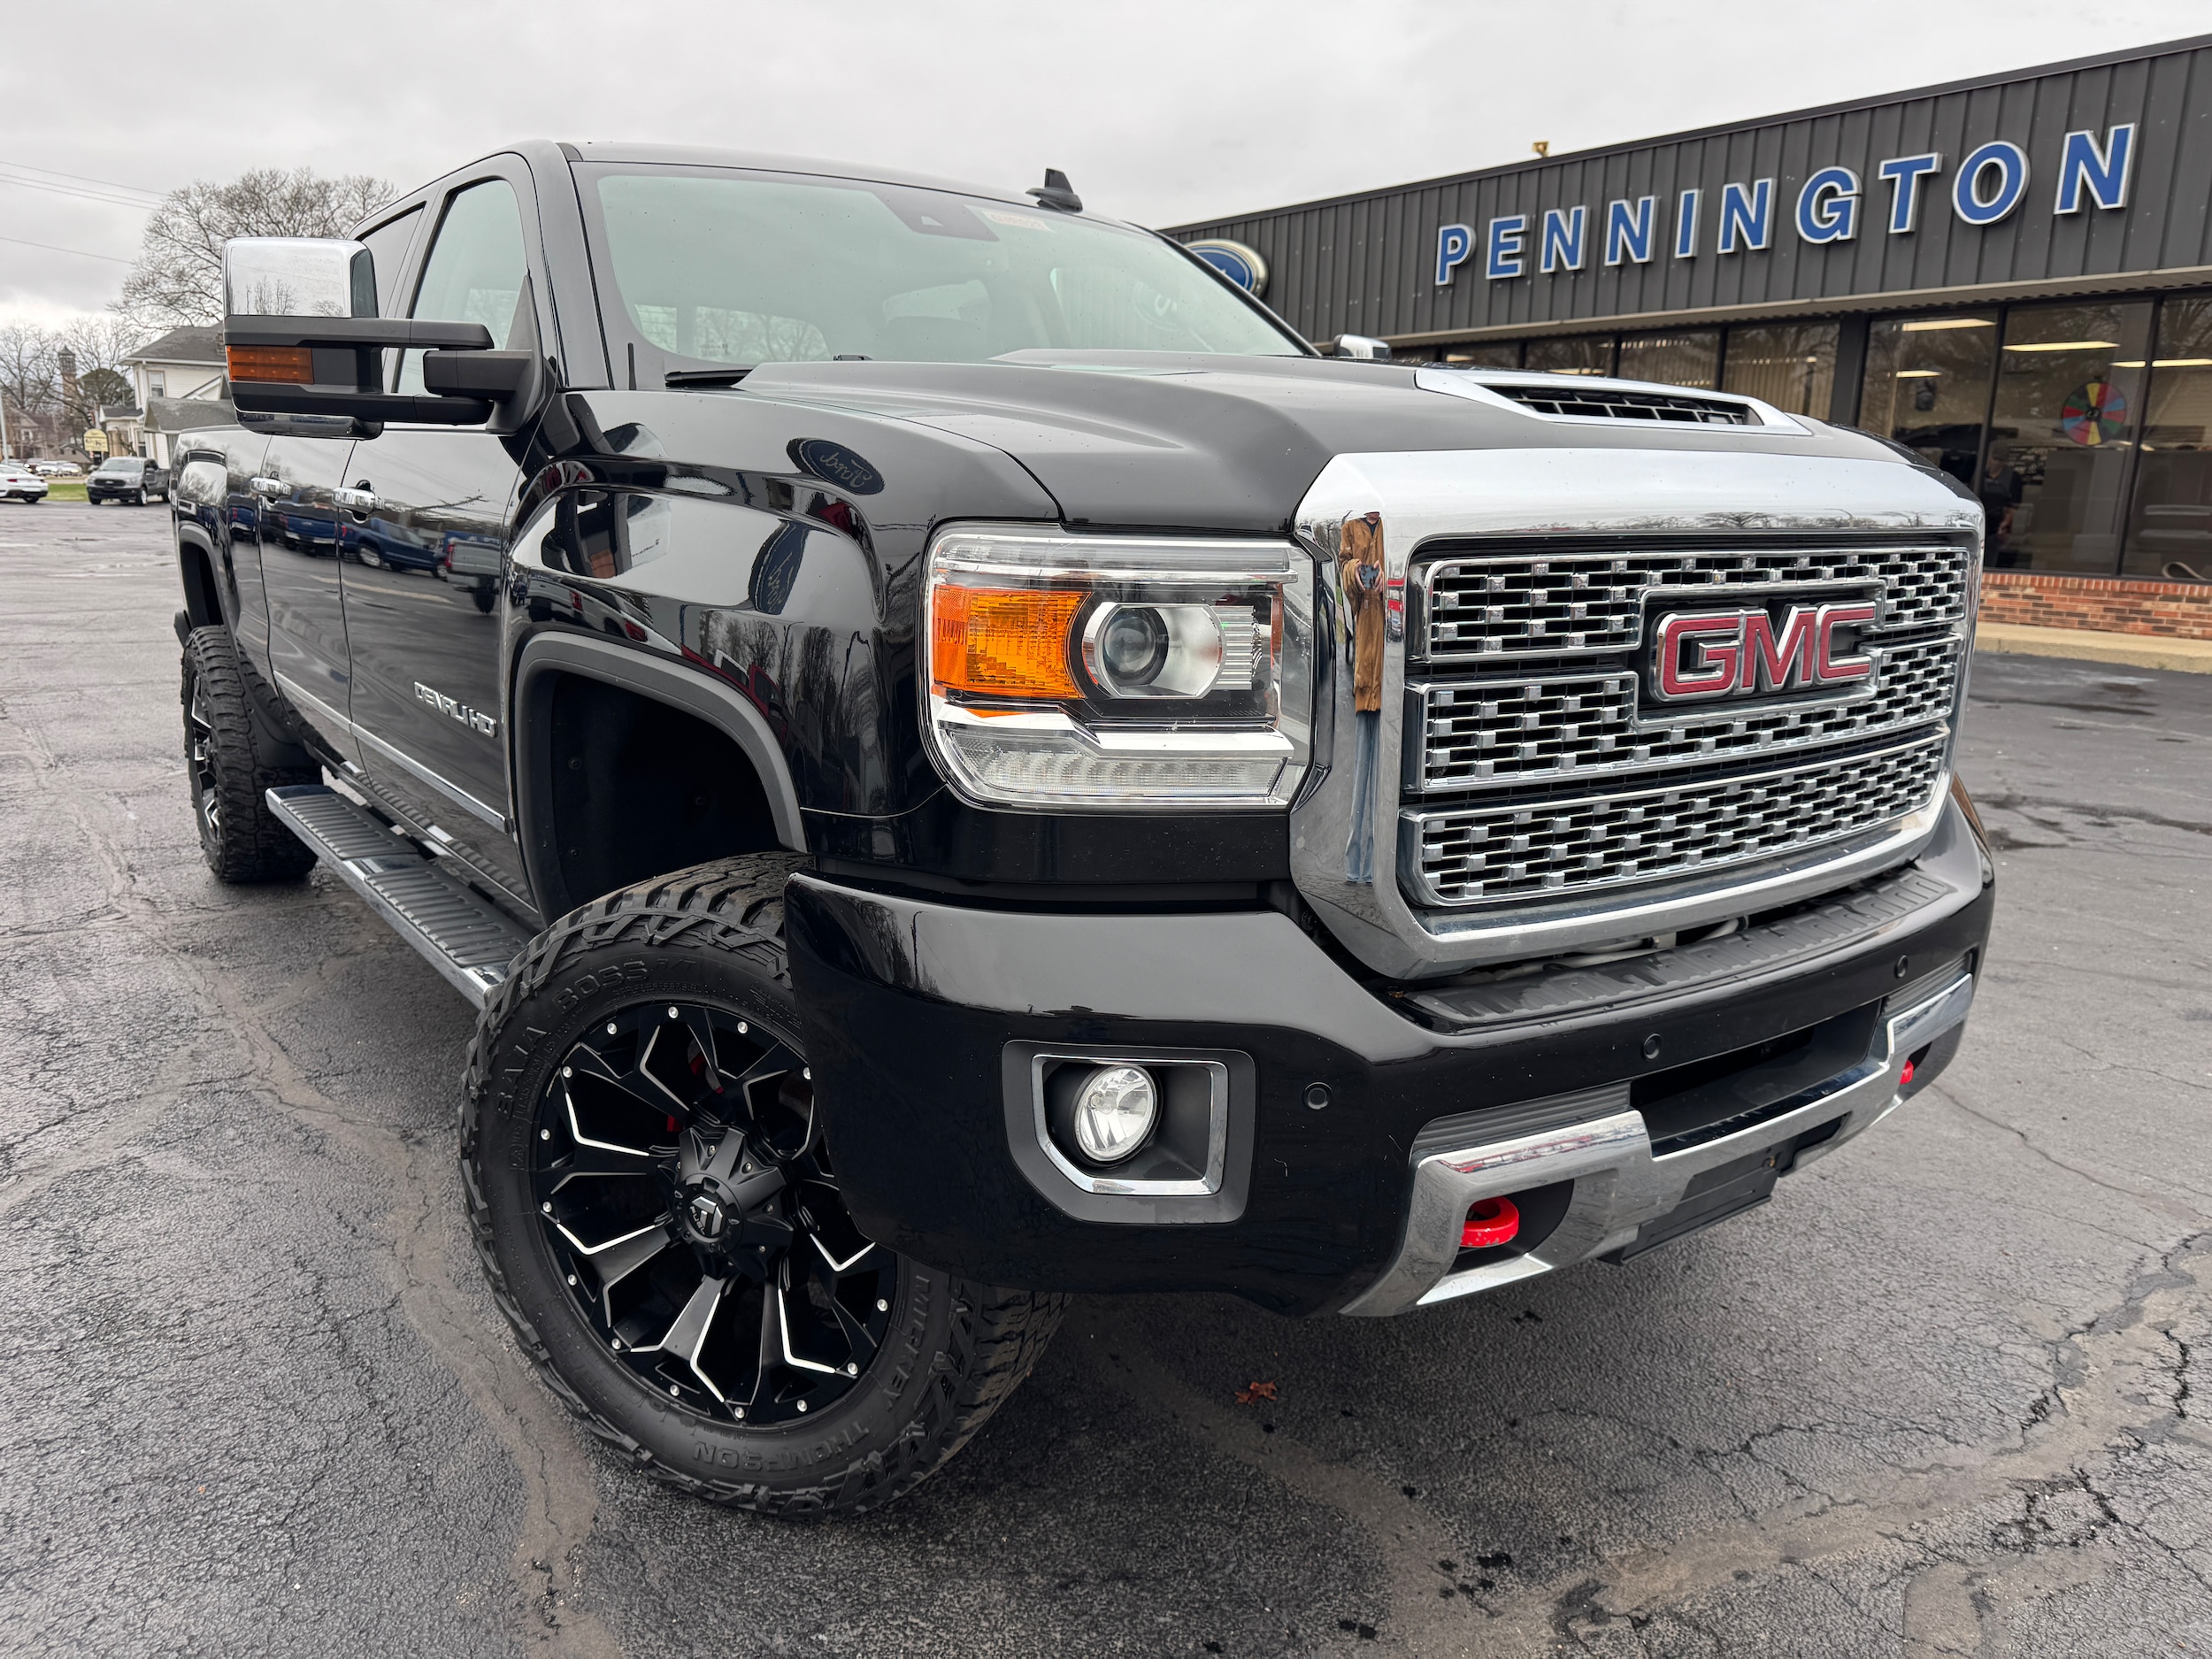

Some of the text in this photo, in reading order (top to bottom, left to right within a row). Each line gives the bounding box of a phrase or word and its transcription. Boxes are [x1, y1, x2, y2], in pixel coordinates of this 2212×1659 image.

[1435, 122, 2137, 286] PENNINGTON
[1654, 601, 1877, 703] GMC
[551, 959, 650, 1015] BOSS
[693, 1273, 932, 1472] MICKEY THOMPSON
